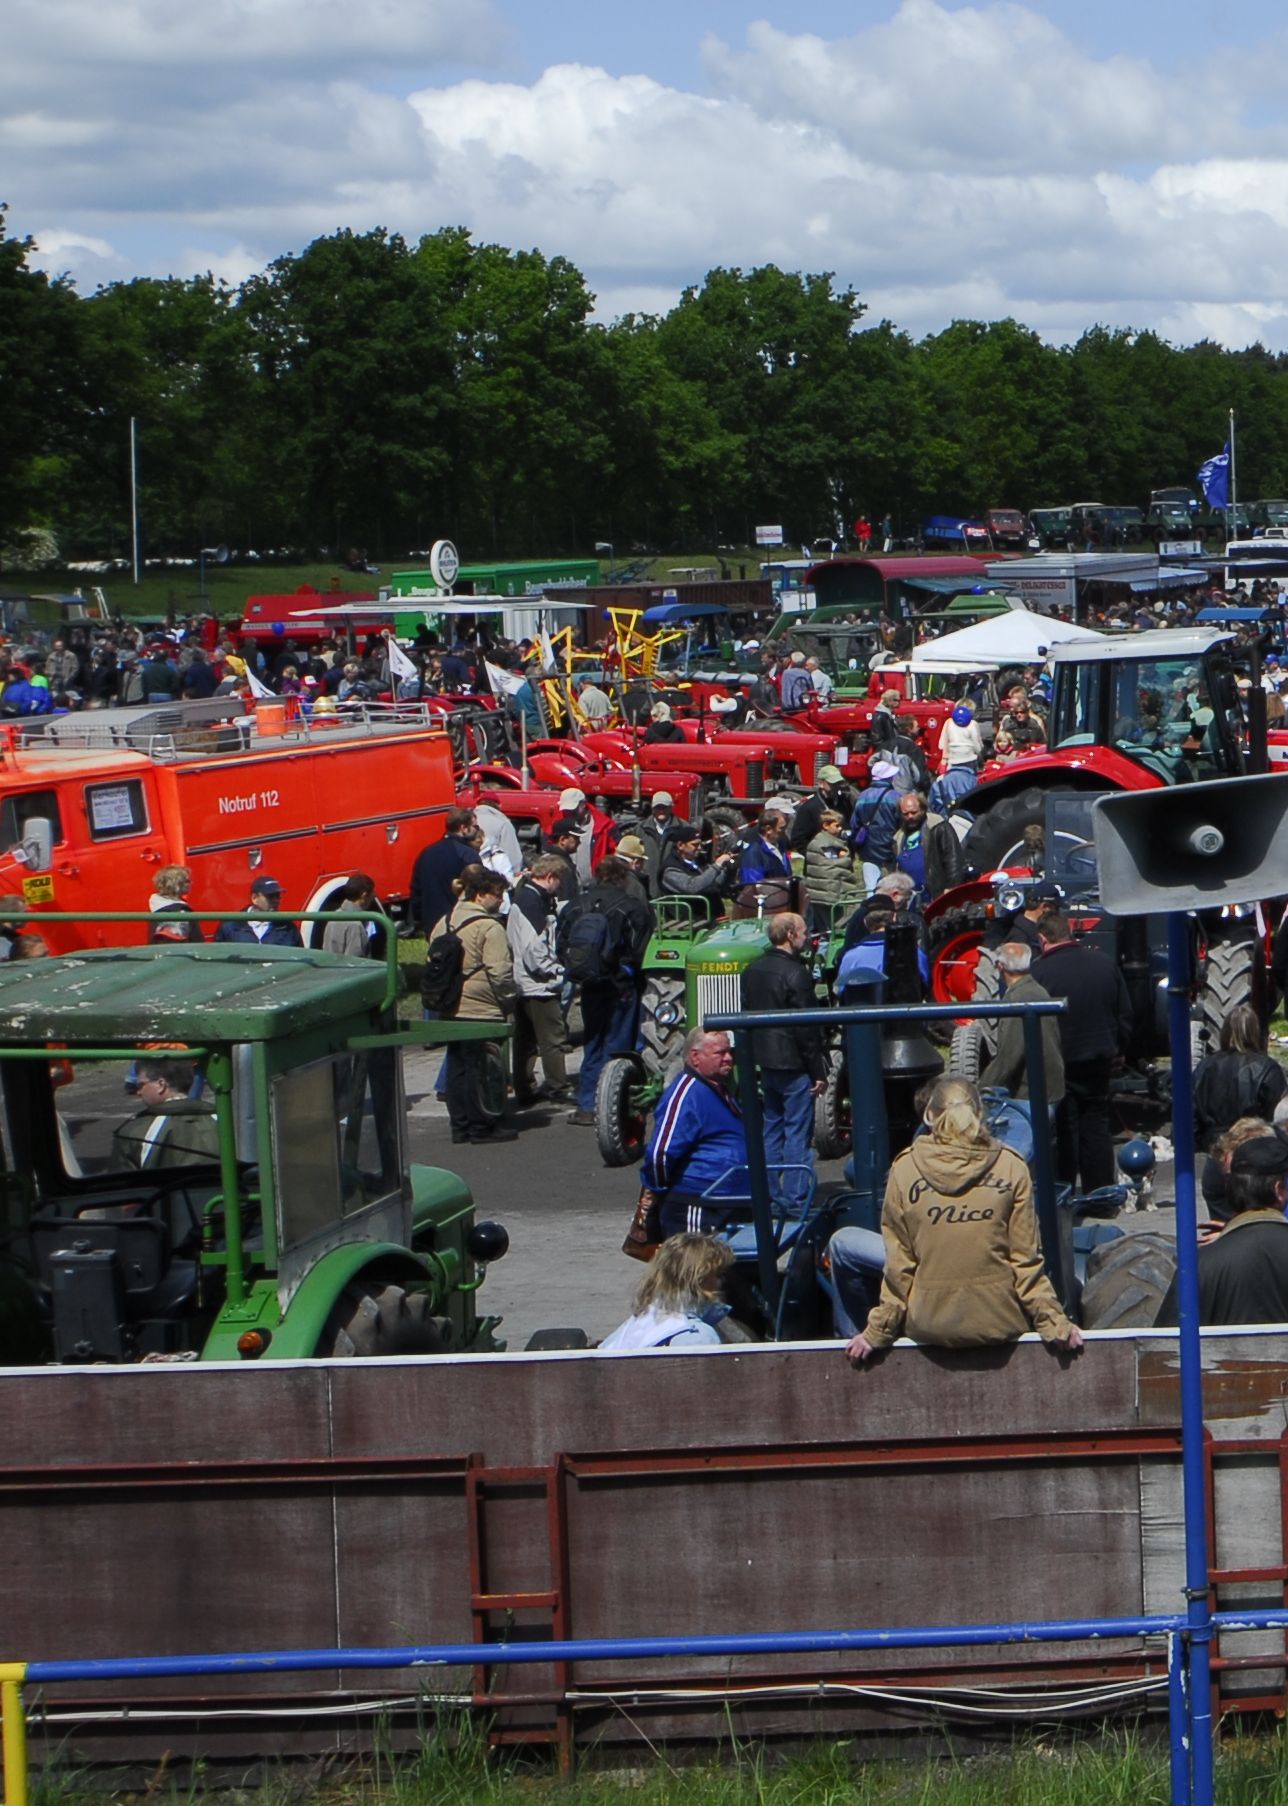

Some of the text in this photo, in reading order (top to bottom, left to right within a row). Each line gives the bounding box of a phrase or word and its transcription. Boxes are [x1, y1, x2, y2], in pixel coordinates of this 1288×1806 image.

[218, 790, 280, 815] Notruf 112
[702, 961, 739, 972] FENDT
[927, 1204, 995, 1226] Nice
